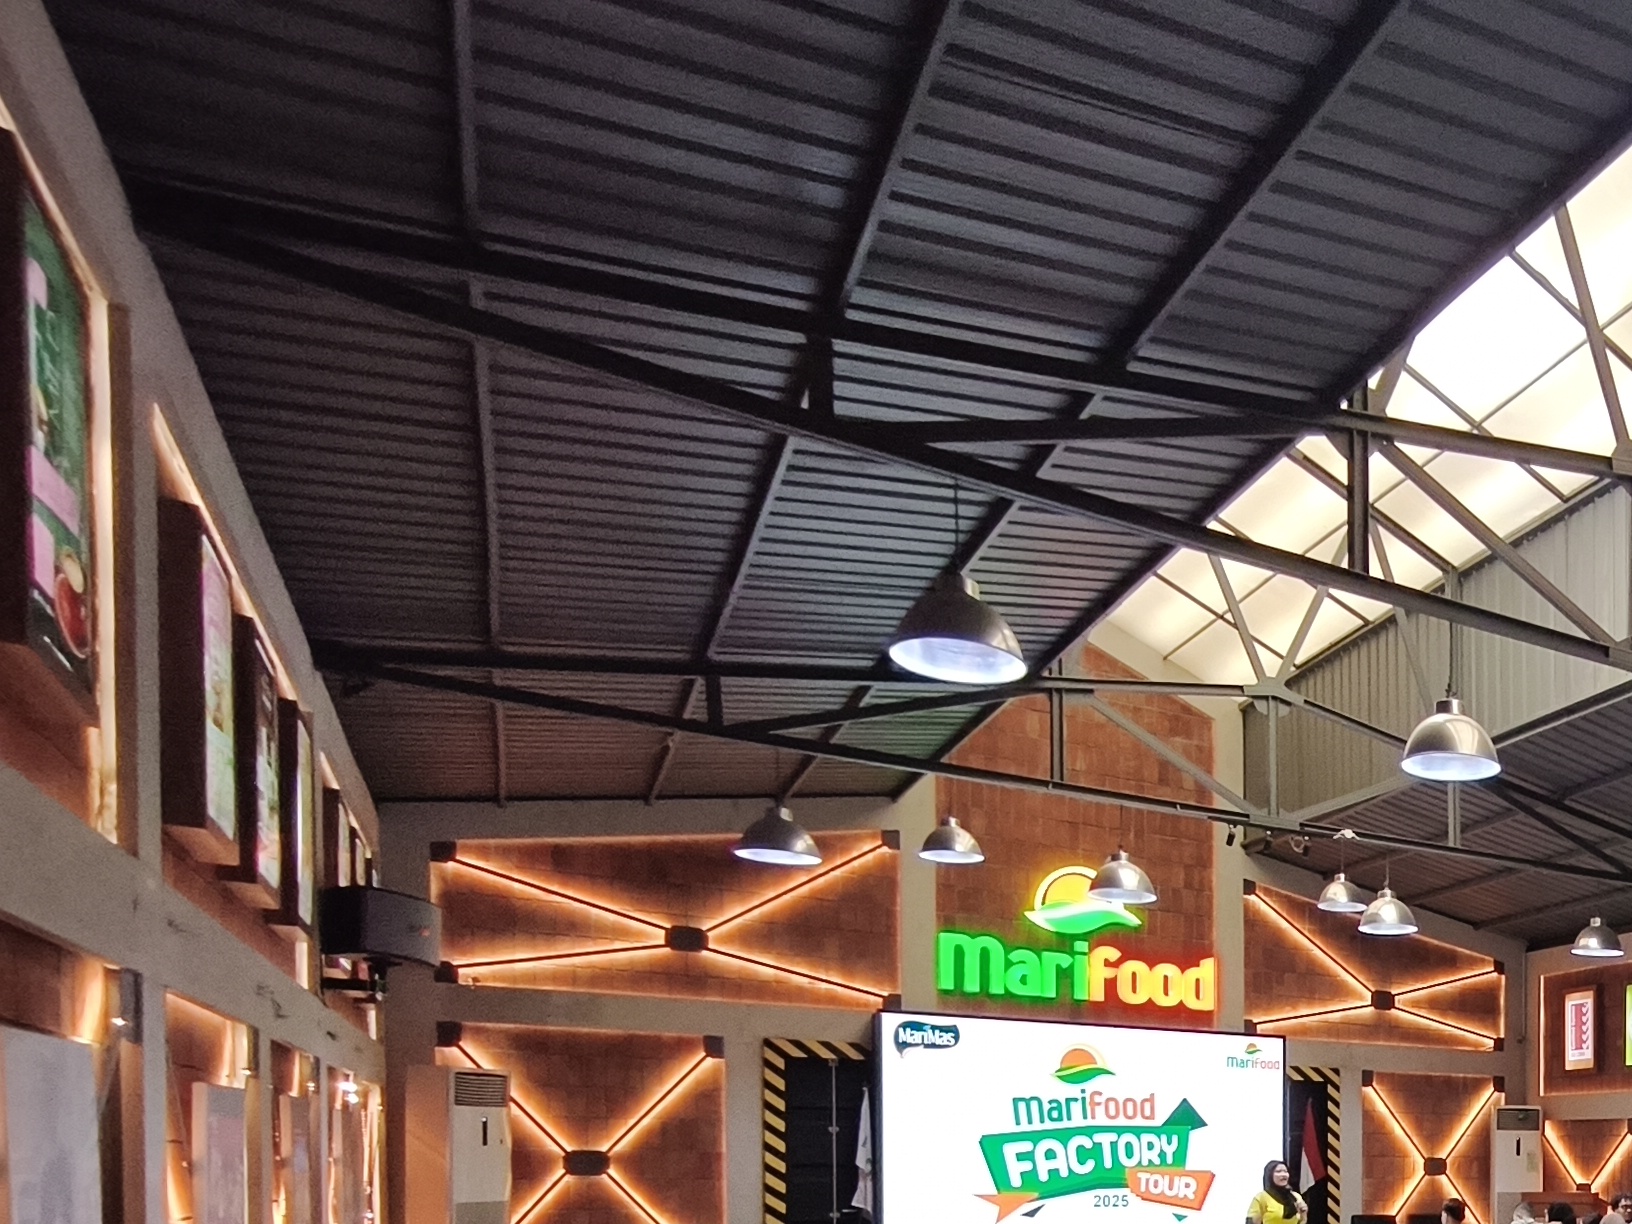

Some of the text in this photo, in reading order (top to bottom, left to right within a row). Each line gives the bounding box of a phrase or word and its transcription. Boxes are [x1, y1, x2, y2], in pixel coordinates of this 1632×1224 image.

[1002, 1131, 1180, 1189] FACTORY
[1136, 1171, 1198, 1200] TOUR
[1093, 1194, 1130, 1208] 2025
